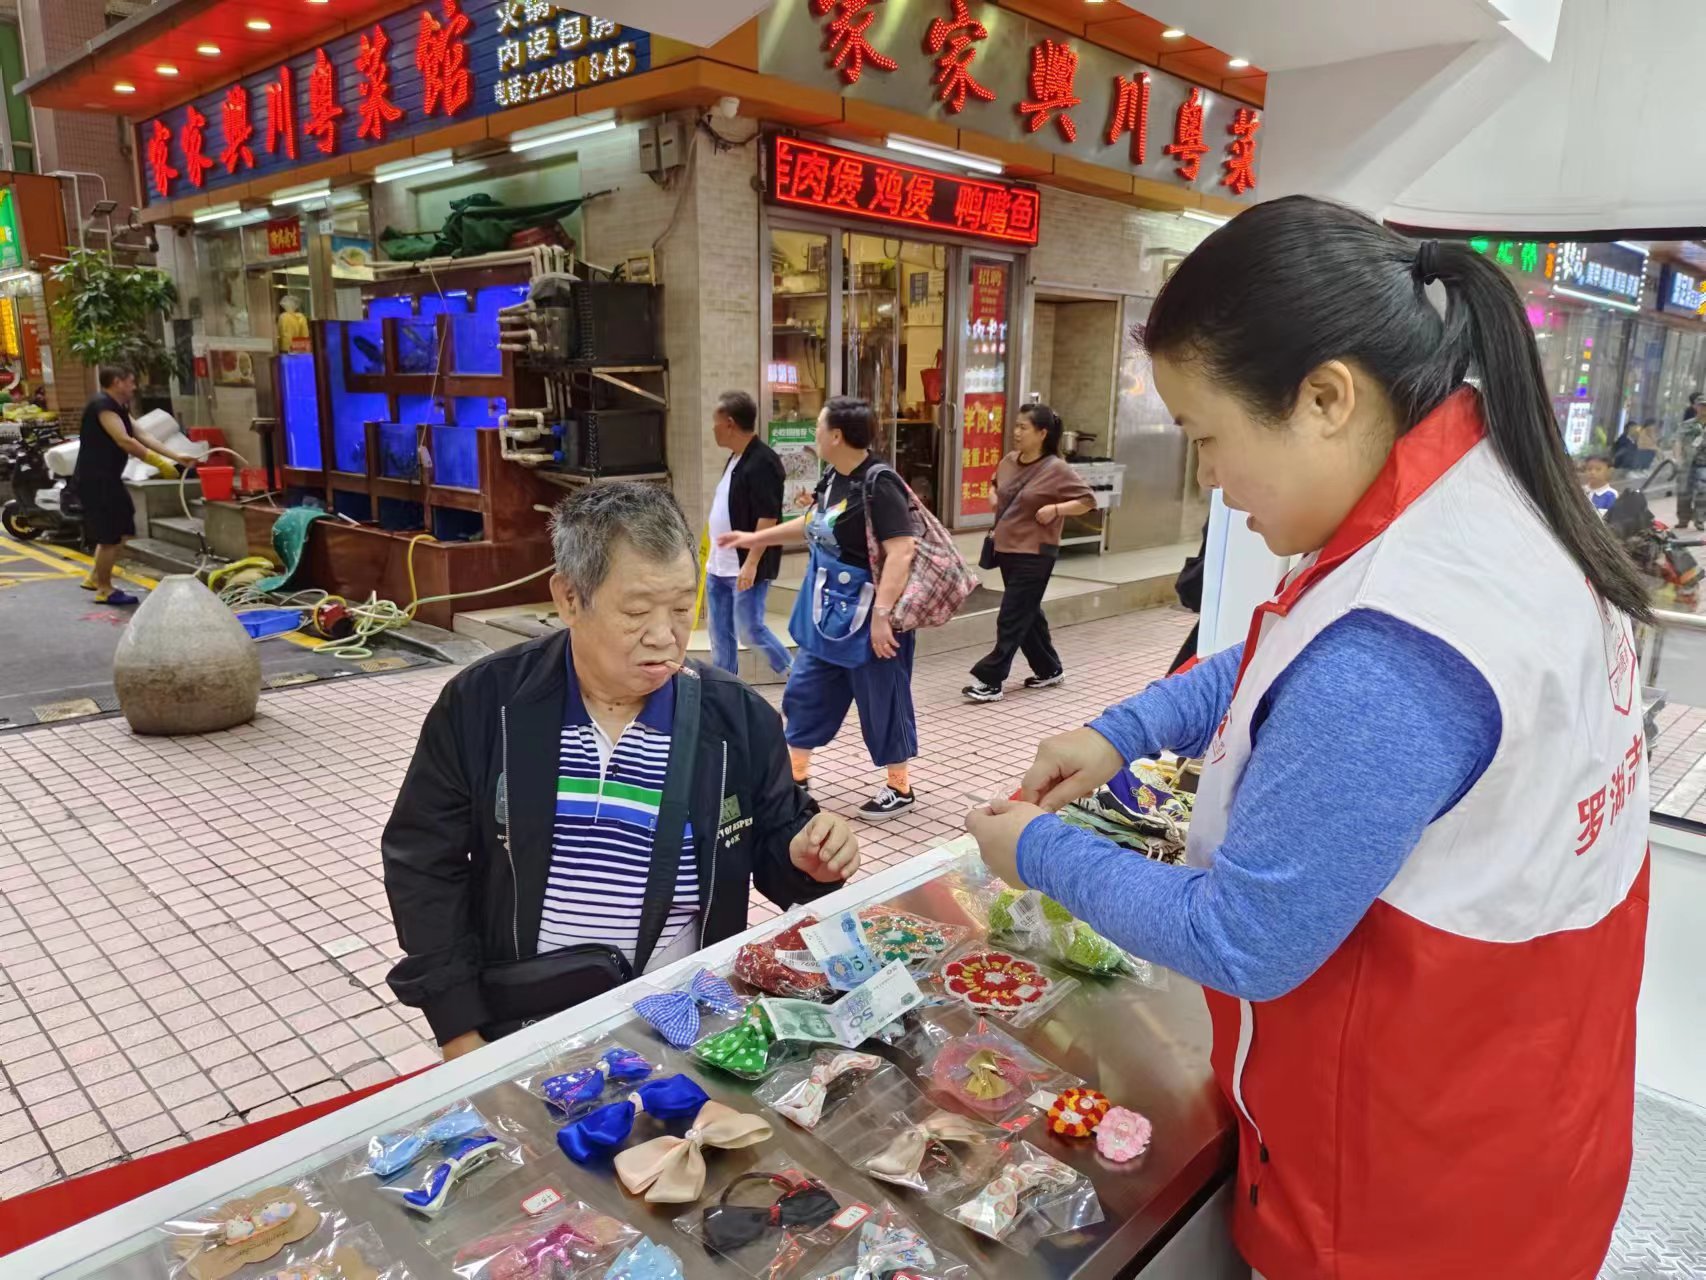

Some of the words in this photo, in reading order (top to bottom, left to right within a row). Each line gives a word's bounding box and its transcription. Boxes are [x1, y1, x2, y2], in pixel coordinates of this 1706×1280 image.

[497, 16, 615, 71] 内设包房
[868, 167, 935, 220] 鸡煲
[978, 268, 1002, 287] 招聘
[849, 1006, 874, 1028] 50
